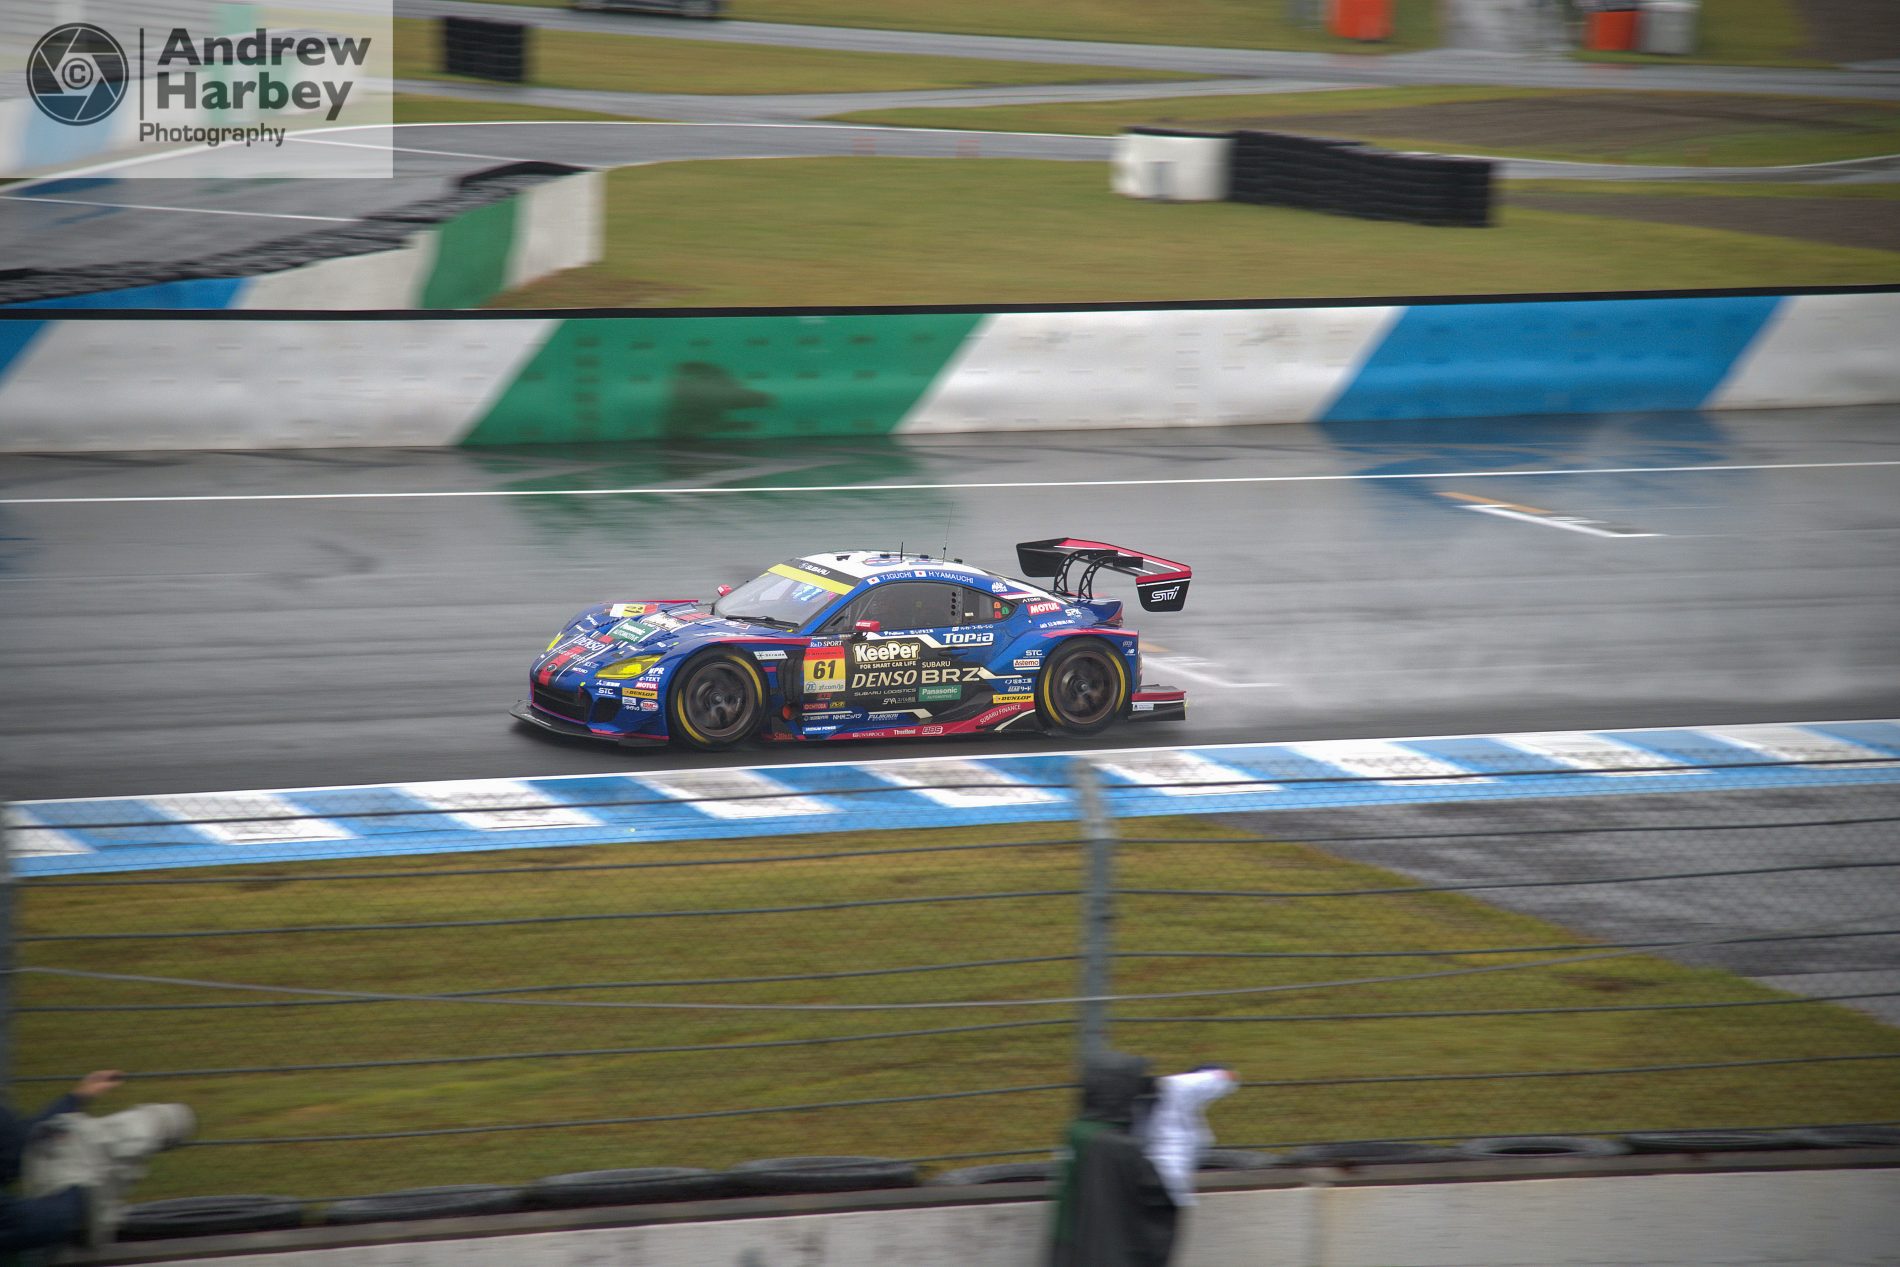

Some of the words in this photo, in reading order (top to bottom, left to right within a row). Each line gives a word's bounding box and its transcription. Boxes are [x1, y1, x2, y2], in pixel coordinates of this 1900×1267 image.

[806, 564, 830, 576] SUBARU
[928, 571, 974, 583] H.YAMAUCHI
[1030, 602, 1060, 614] MOTUL
[573, 636, 605, 651] DENSO
[854, 642, 919, 662] KeePer
[813, 660, 836, 680] 61
[921, 667, 980, 684] BRZ
[851, 670, 918, 688] DENSO
[921, 687, 958, 695] Panasonic
[980, 711, 999, 724] SUBARU
[999, 704, 1022, 715] FINANCE
